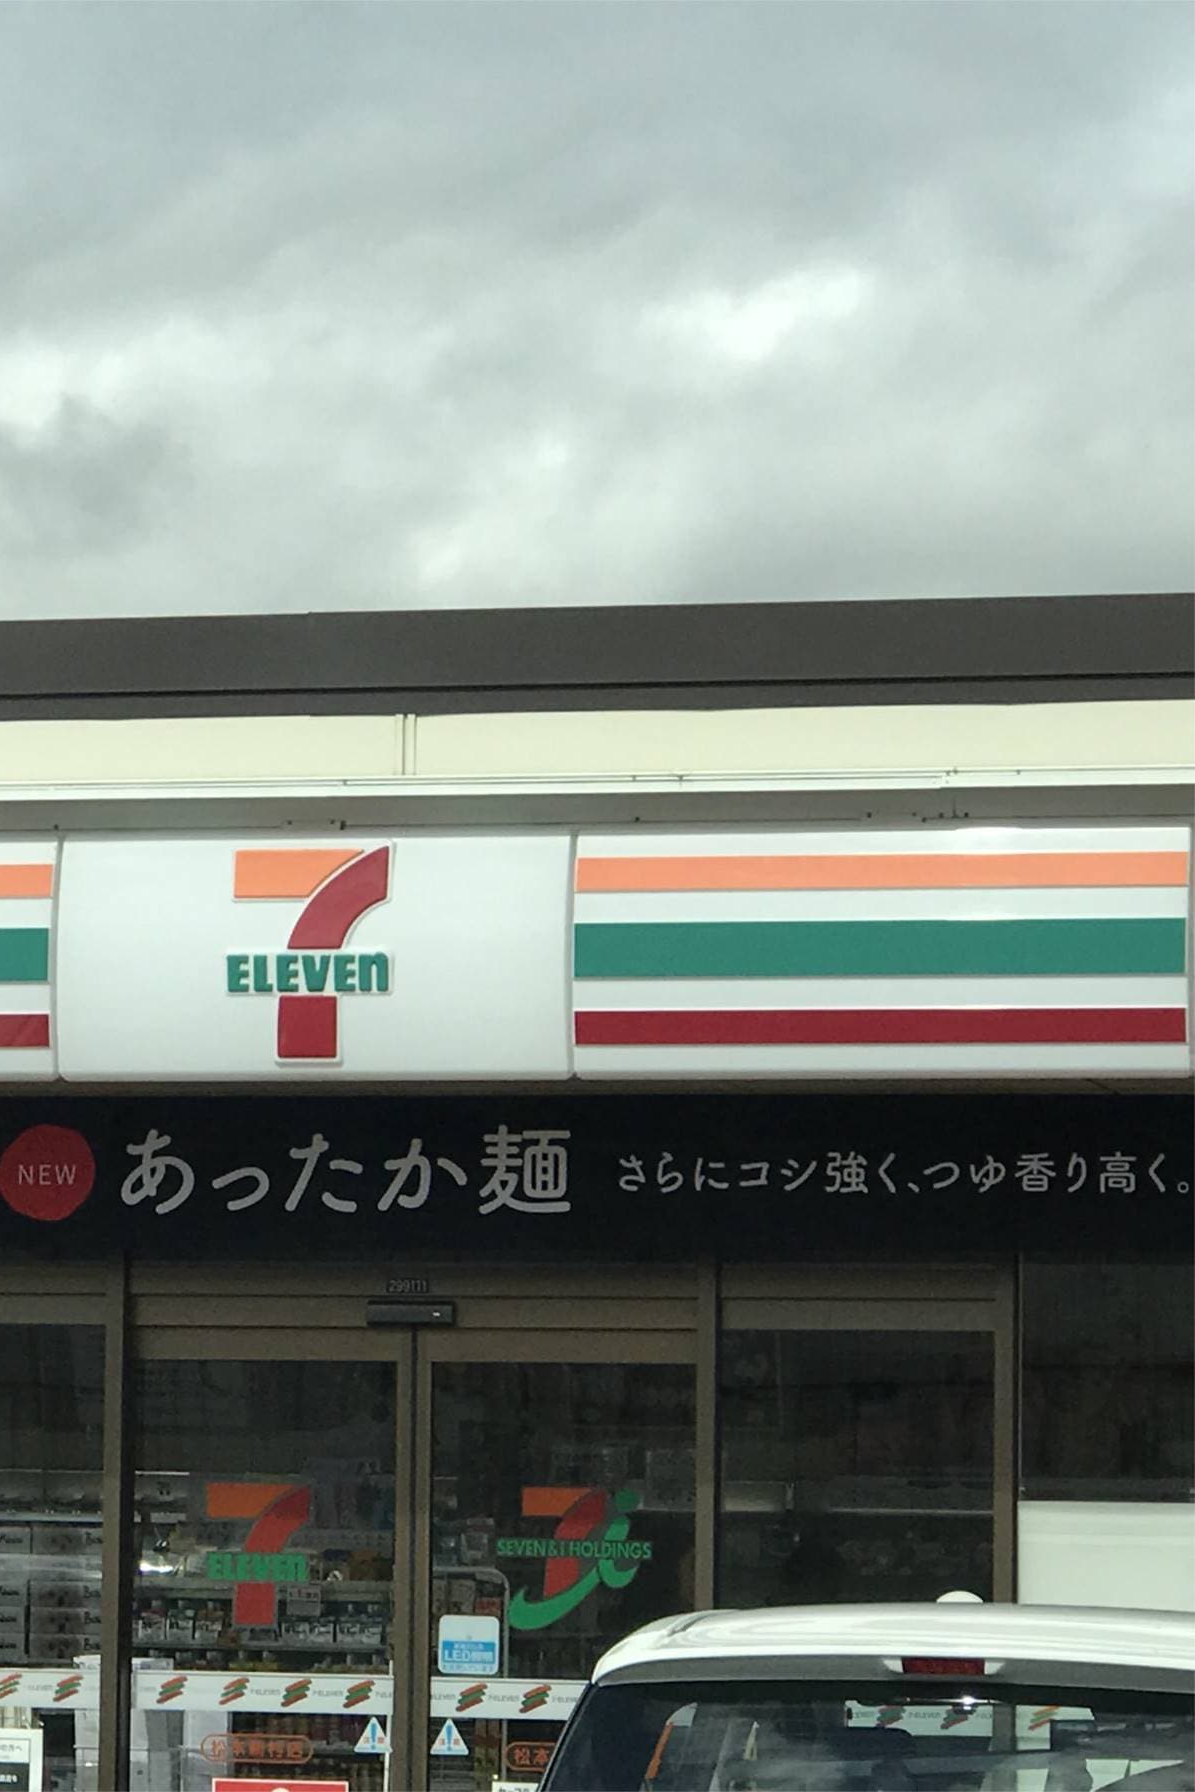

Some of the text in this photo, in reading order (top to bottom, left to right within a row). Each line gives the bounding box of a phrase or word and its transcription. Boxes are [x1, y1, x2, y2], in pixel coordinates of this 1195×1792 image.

[17, 1164, 76, 1186] NEW
[121, 1124, 572, 1214] あったか麺
[568, 1540, 652, 1560] HOLDINGS
